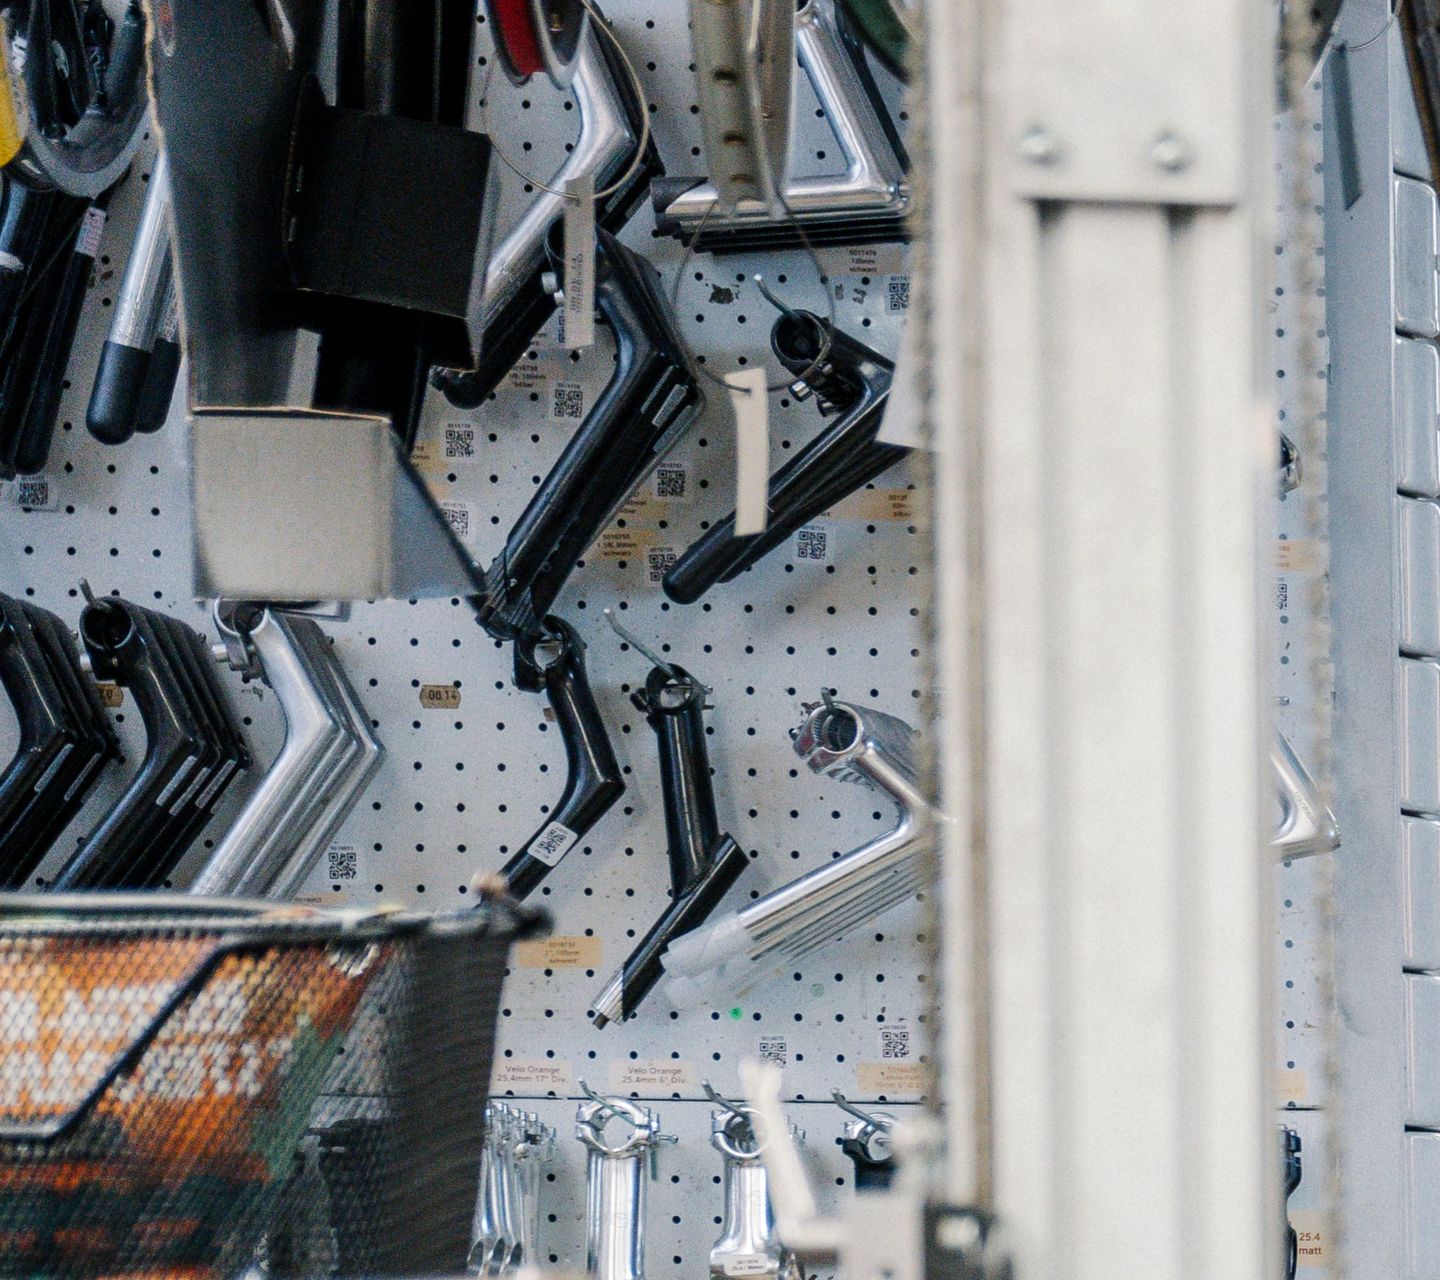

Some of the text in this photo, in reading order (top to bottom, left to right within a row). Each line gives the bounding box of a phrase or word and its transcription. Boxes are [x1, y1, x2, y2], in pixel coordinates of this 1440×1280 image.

[505, 1065, 560, 1076] Velo Orange
[627, 1066, 682, 1077] Velo Orange
